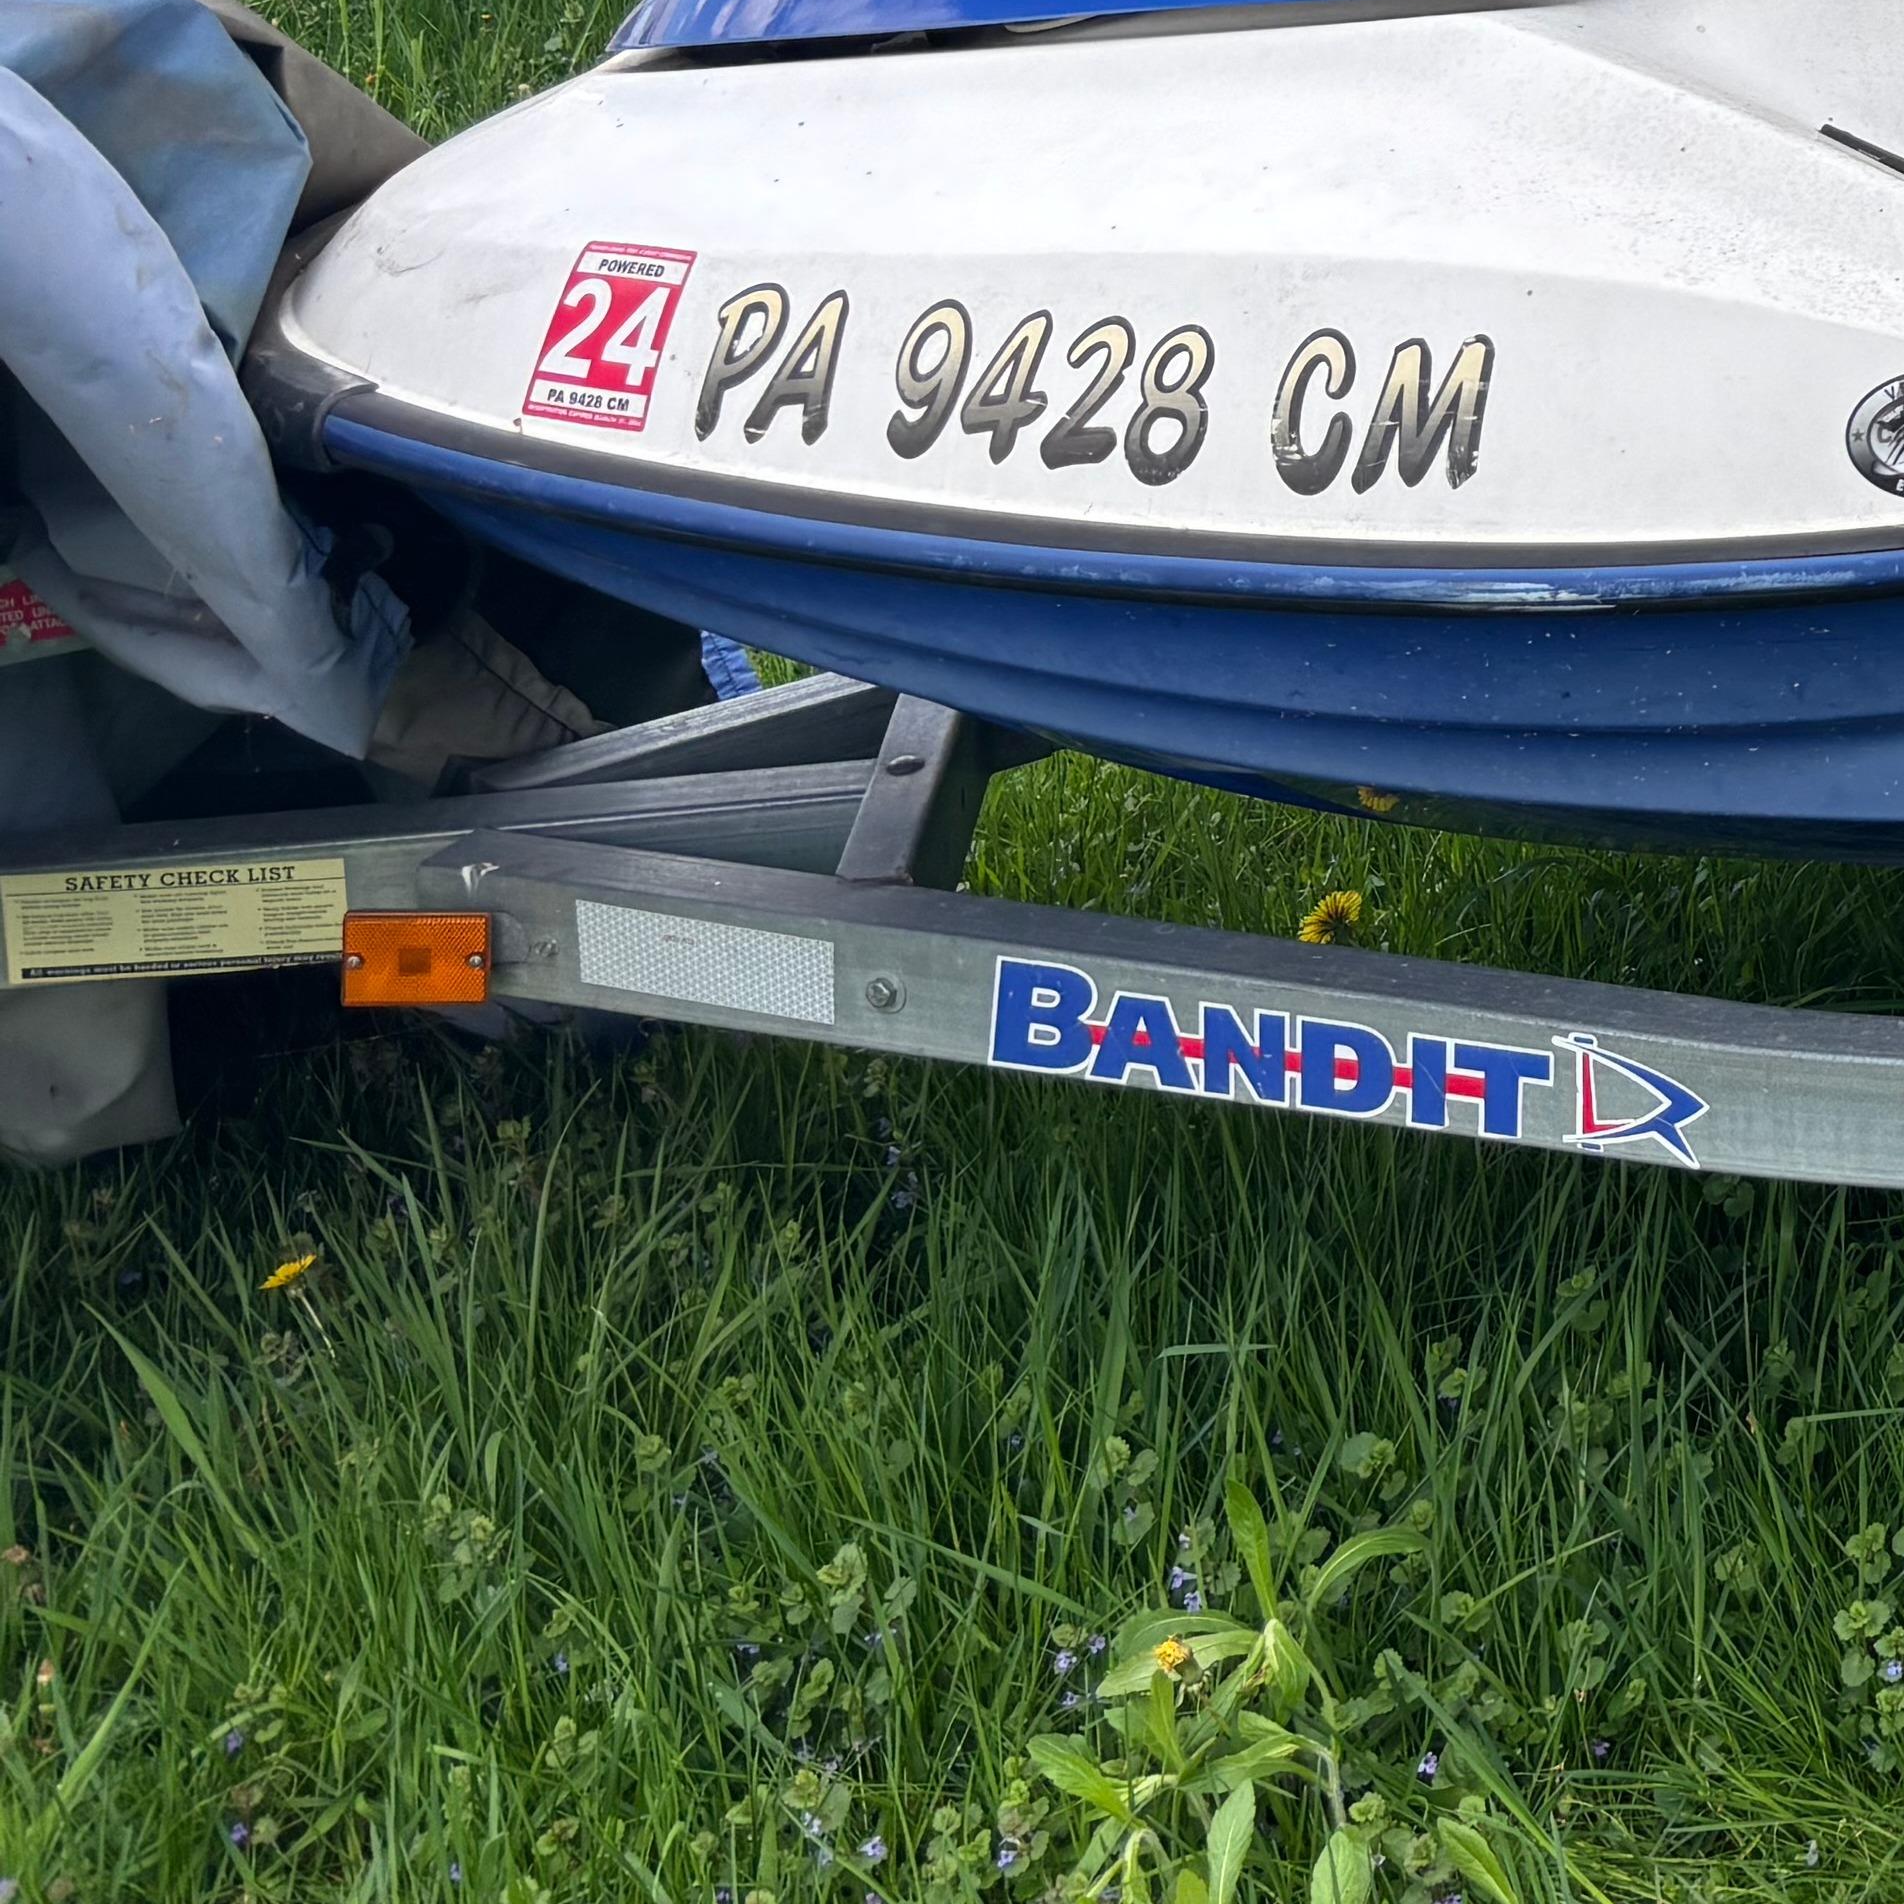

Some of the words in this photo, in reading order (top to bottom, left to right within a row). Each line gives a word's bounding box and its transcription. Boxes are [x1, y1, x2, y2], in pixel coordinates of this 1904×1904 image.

[597, 258, 666, 278] POWERED
[538, 277, 672, 387] 24
[547, 388, 565, 404] PA
[569, 391, 603, 409] 9428
[606, 397, 630, 412] CM
[695, 282, 851, 444] PA
[885, 298, 1214, 487] 9428
[1270, 327, 1496, 496] CM
[65, 873, 151, 892] SAFETY
[160, 869, 240, 887] CHECK
[248, 865, 295, 882] LIST
[988, 955, 1555, 1140] BANDIT
